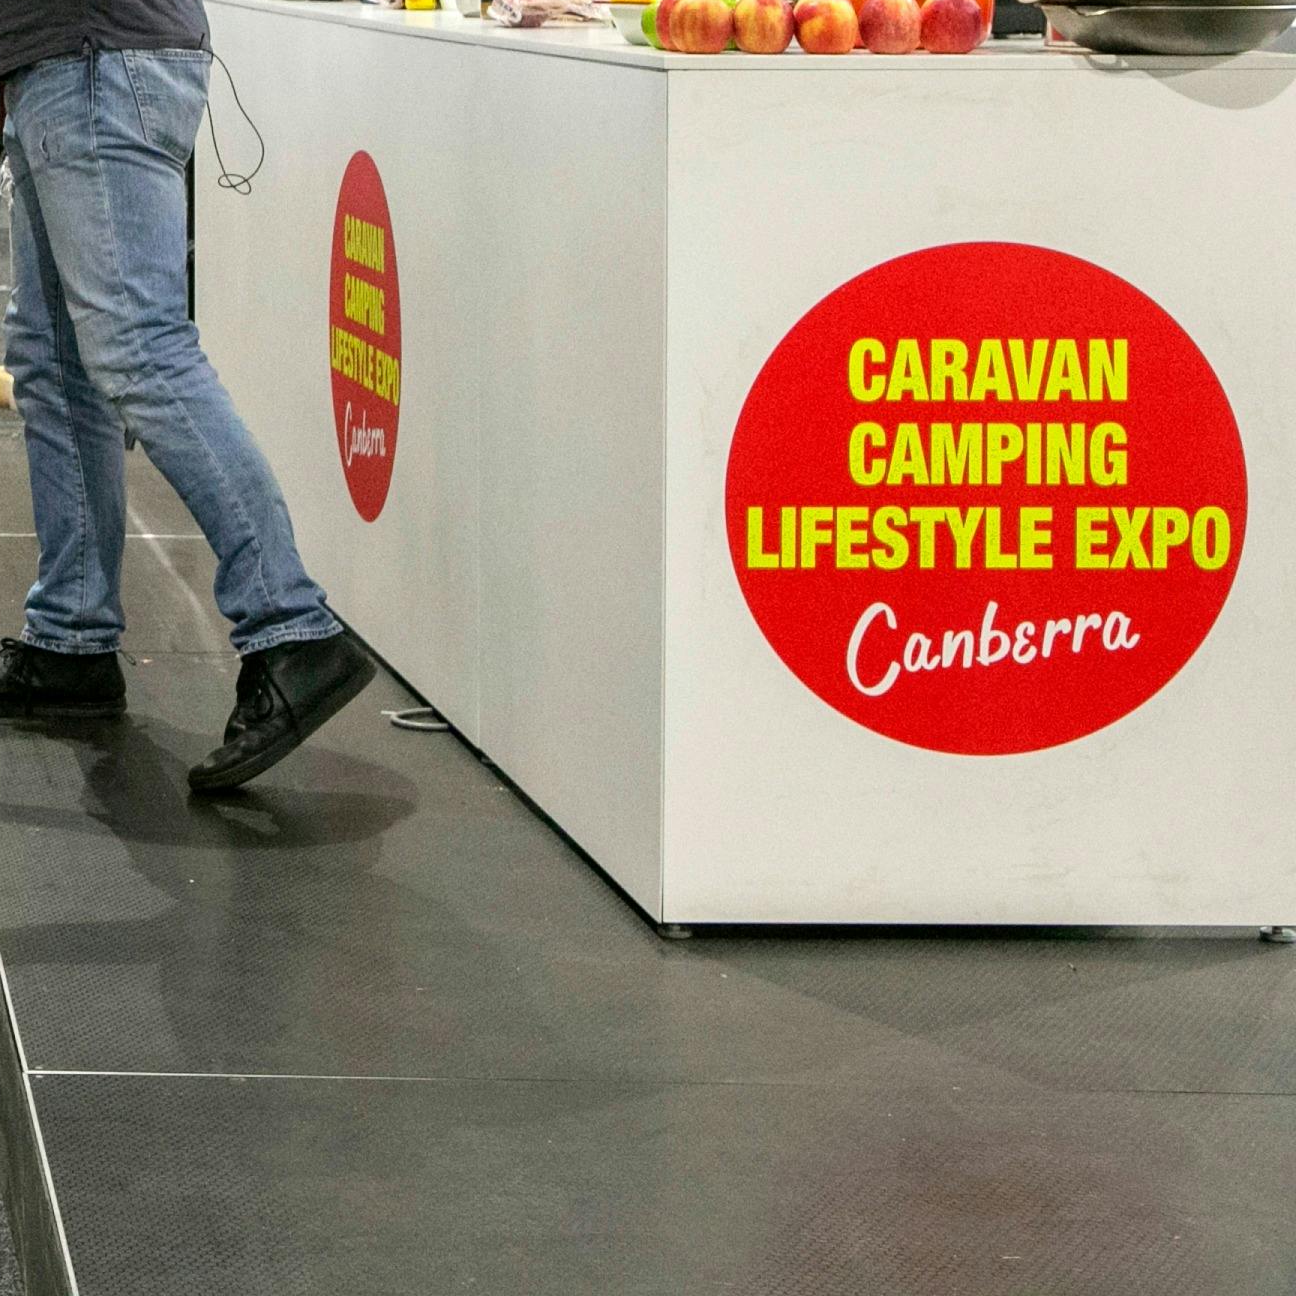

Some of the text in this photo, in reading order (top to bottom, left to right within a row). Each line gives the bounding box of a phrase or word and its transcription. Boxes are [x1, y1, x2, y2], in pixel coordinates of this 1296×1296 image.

[344, 214, 385, 273] CARAVAN
[344, 272, 385, 336] CAMPING
[331, 324, 400, 407] LIFESTYLE EXPO
[848, 337, 1128, 402] CARAVAN
[344, 401, 387, 467] Canberra
[848, 422, 1128, 487] CAMPING
[746, 505, 1231, 571] LIFESTYLE EXPO
[846, 600, 1141, 697] Canberra
